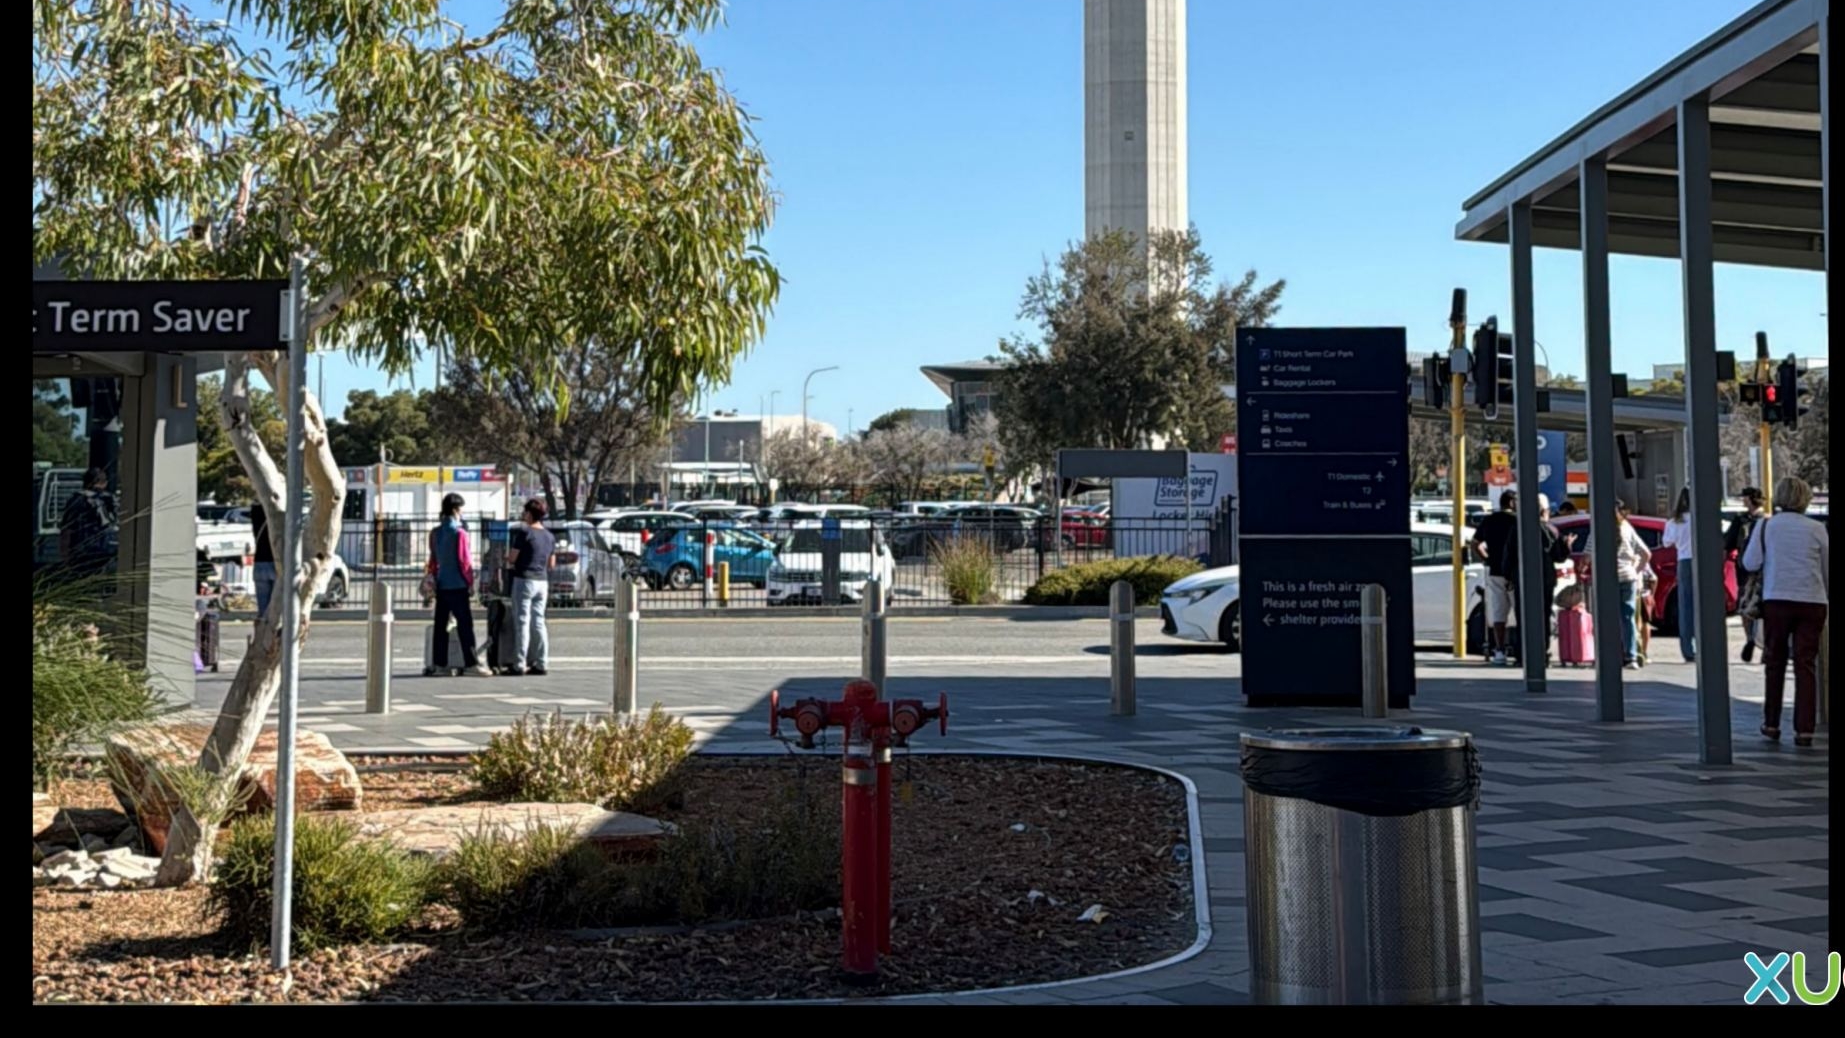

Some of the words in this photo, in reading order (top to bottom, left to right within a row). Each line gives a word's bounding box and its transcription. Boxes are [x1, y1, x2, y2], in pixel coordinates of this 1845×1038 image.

[47, 300, 140, 333] Term
[152, 300, 251, 333] Saver
[1282, 349, 1303, 358] Short
[1304, 349, 1322, 358] Term
[1323, 349, 1336, 358] Car
[1337, 349, 1354, 358] Park
[1272, 364, 1286, 373] Car
[1287, 364, 1312, 373] Rental
[1273, 379, 1306, 388] Baggage
[1307, 378, 1336, 387] Lockers
[1162, 475, 1213, 488] Bagage
[1153, 507, 1195, 520] Locke
[1262, 580, 1285, 592] This
[1287, 580, 1297, 592] is
[1298, 583, 1306, 592] a
[1308, 580, 1336, 592] fresh
[1338, 580, 1352, 592] air
[1262, 597, 1297, 609] Please
[1299, 599, 1319, 609] use
[1321, 597, 1340, 609] the
[1280, 613, 1317, 625] shelter
[1320, 613, 1362, 627] provide
